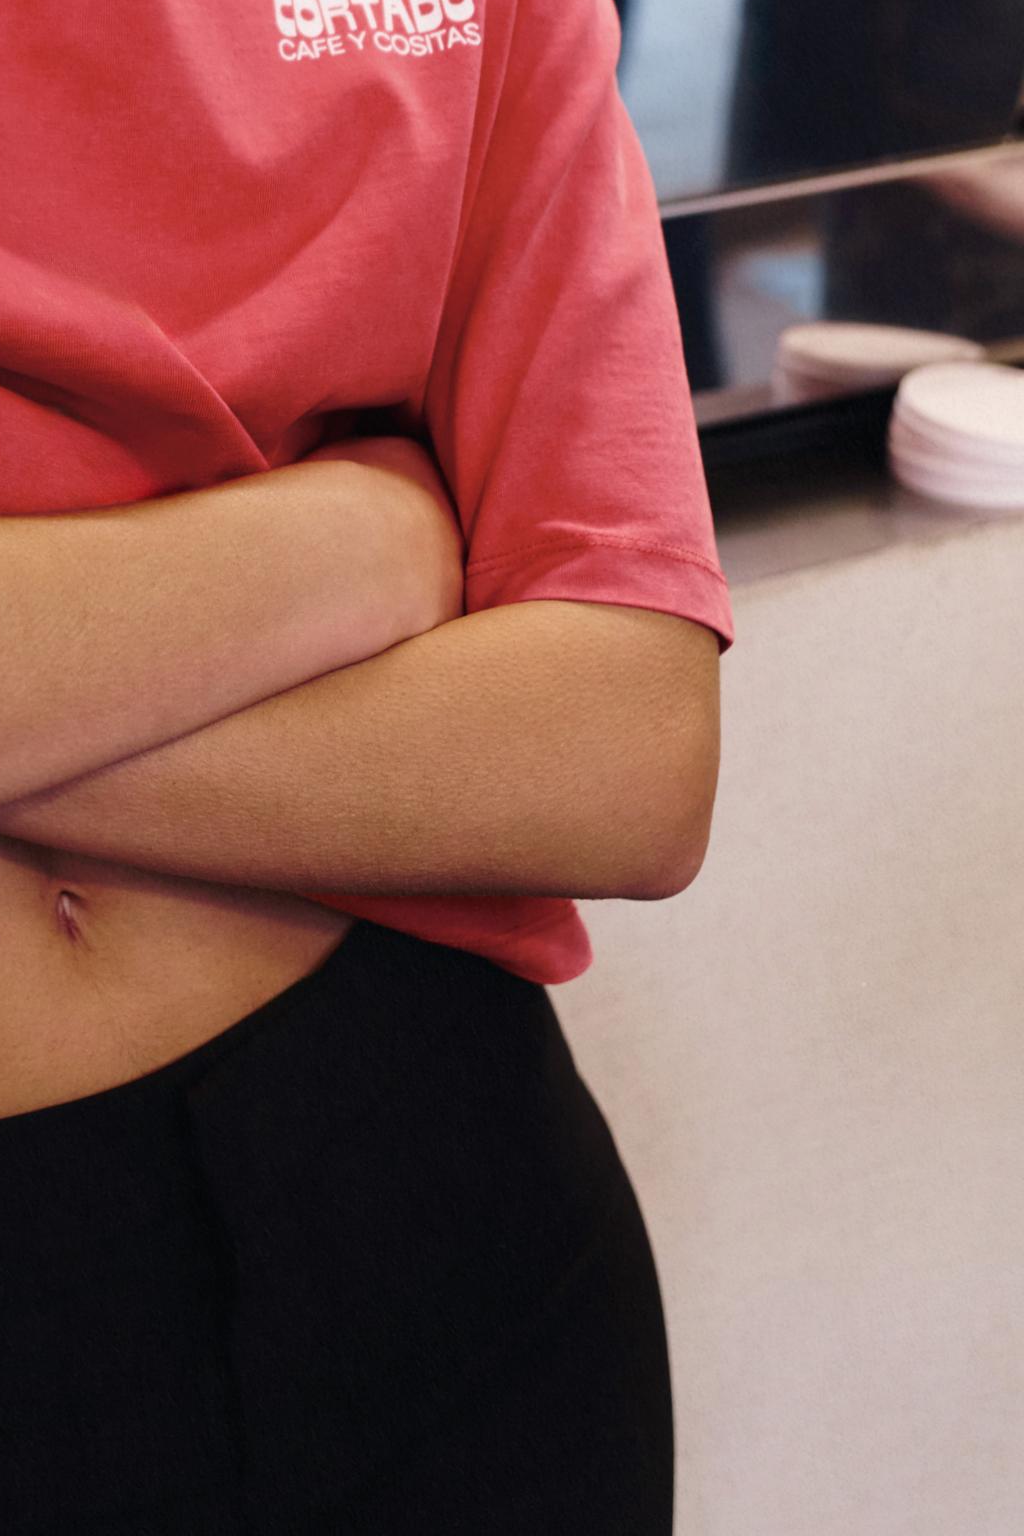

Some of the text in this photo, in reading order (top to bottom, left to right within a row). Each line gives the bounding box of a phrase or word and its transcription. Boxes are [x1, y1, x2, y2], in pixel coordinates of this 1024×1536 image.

[279, 22, 482, 61] CAFE Y COSITAS
